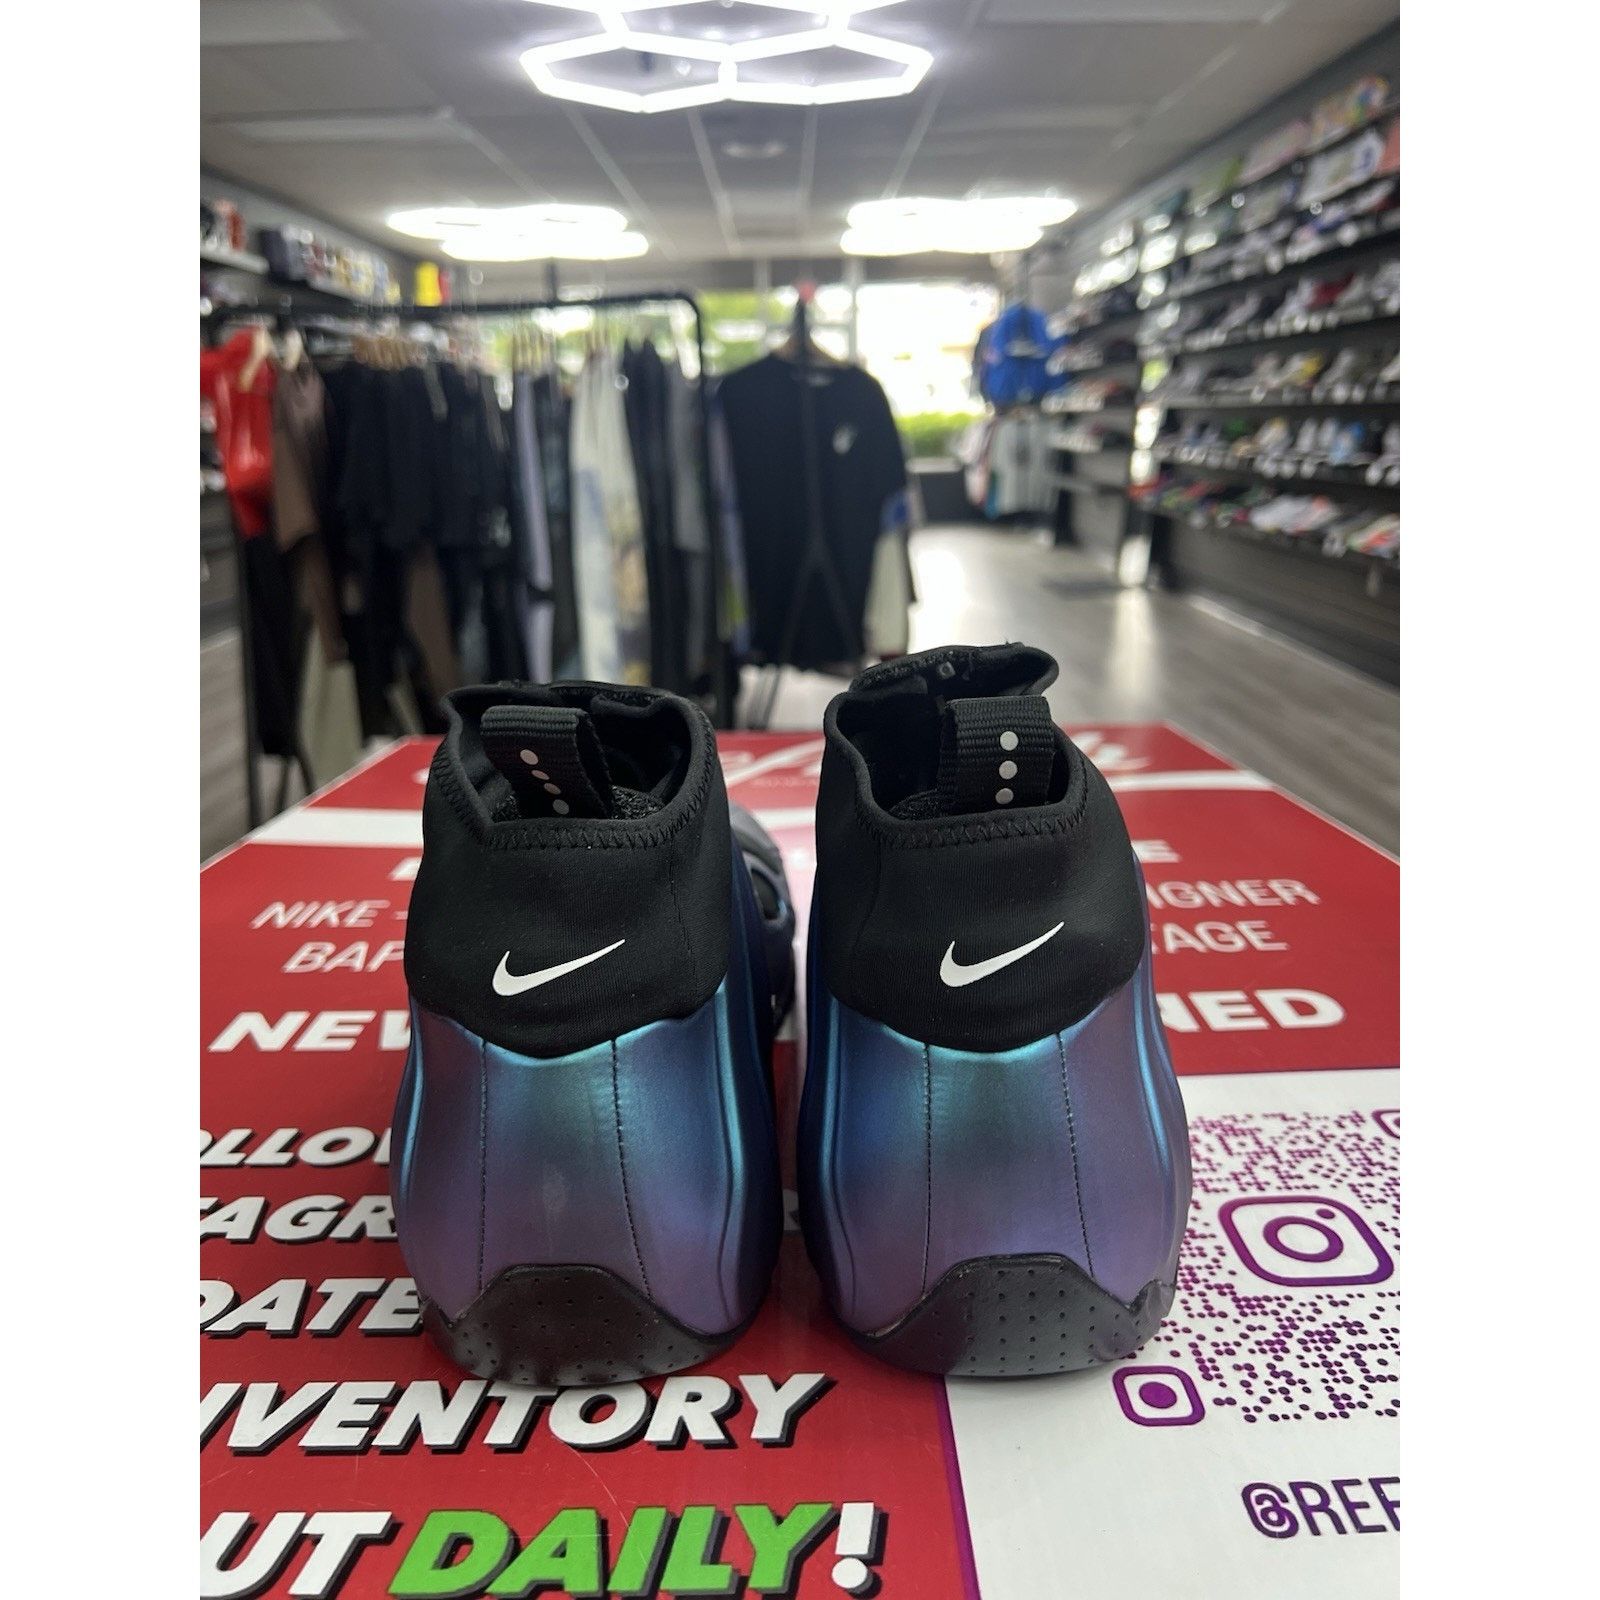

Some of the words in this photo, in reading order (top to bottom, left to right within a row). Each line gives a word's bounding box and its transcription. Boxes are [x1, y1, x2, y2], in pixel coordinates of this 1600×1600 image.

[251, 900, 391, 929] NIKE
[1150, 920, 1290, 954] AGE
[200, 1126, 392, 1166] LLO
[389, 1501, 876, 1597] DAILY!
